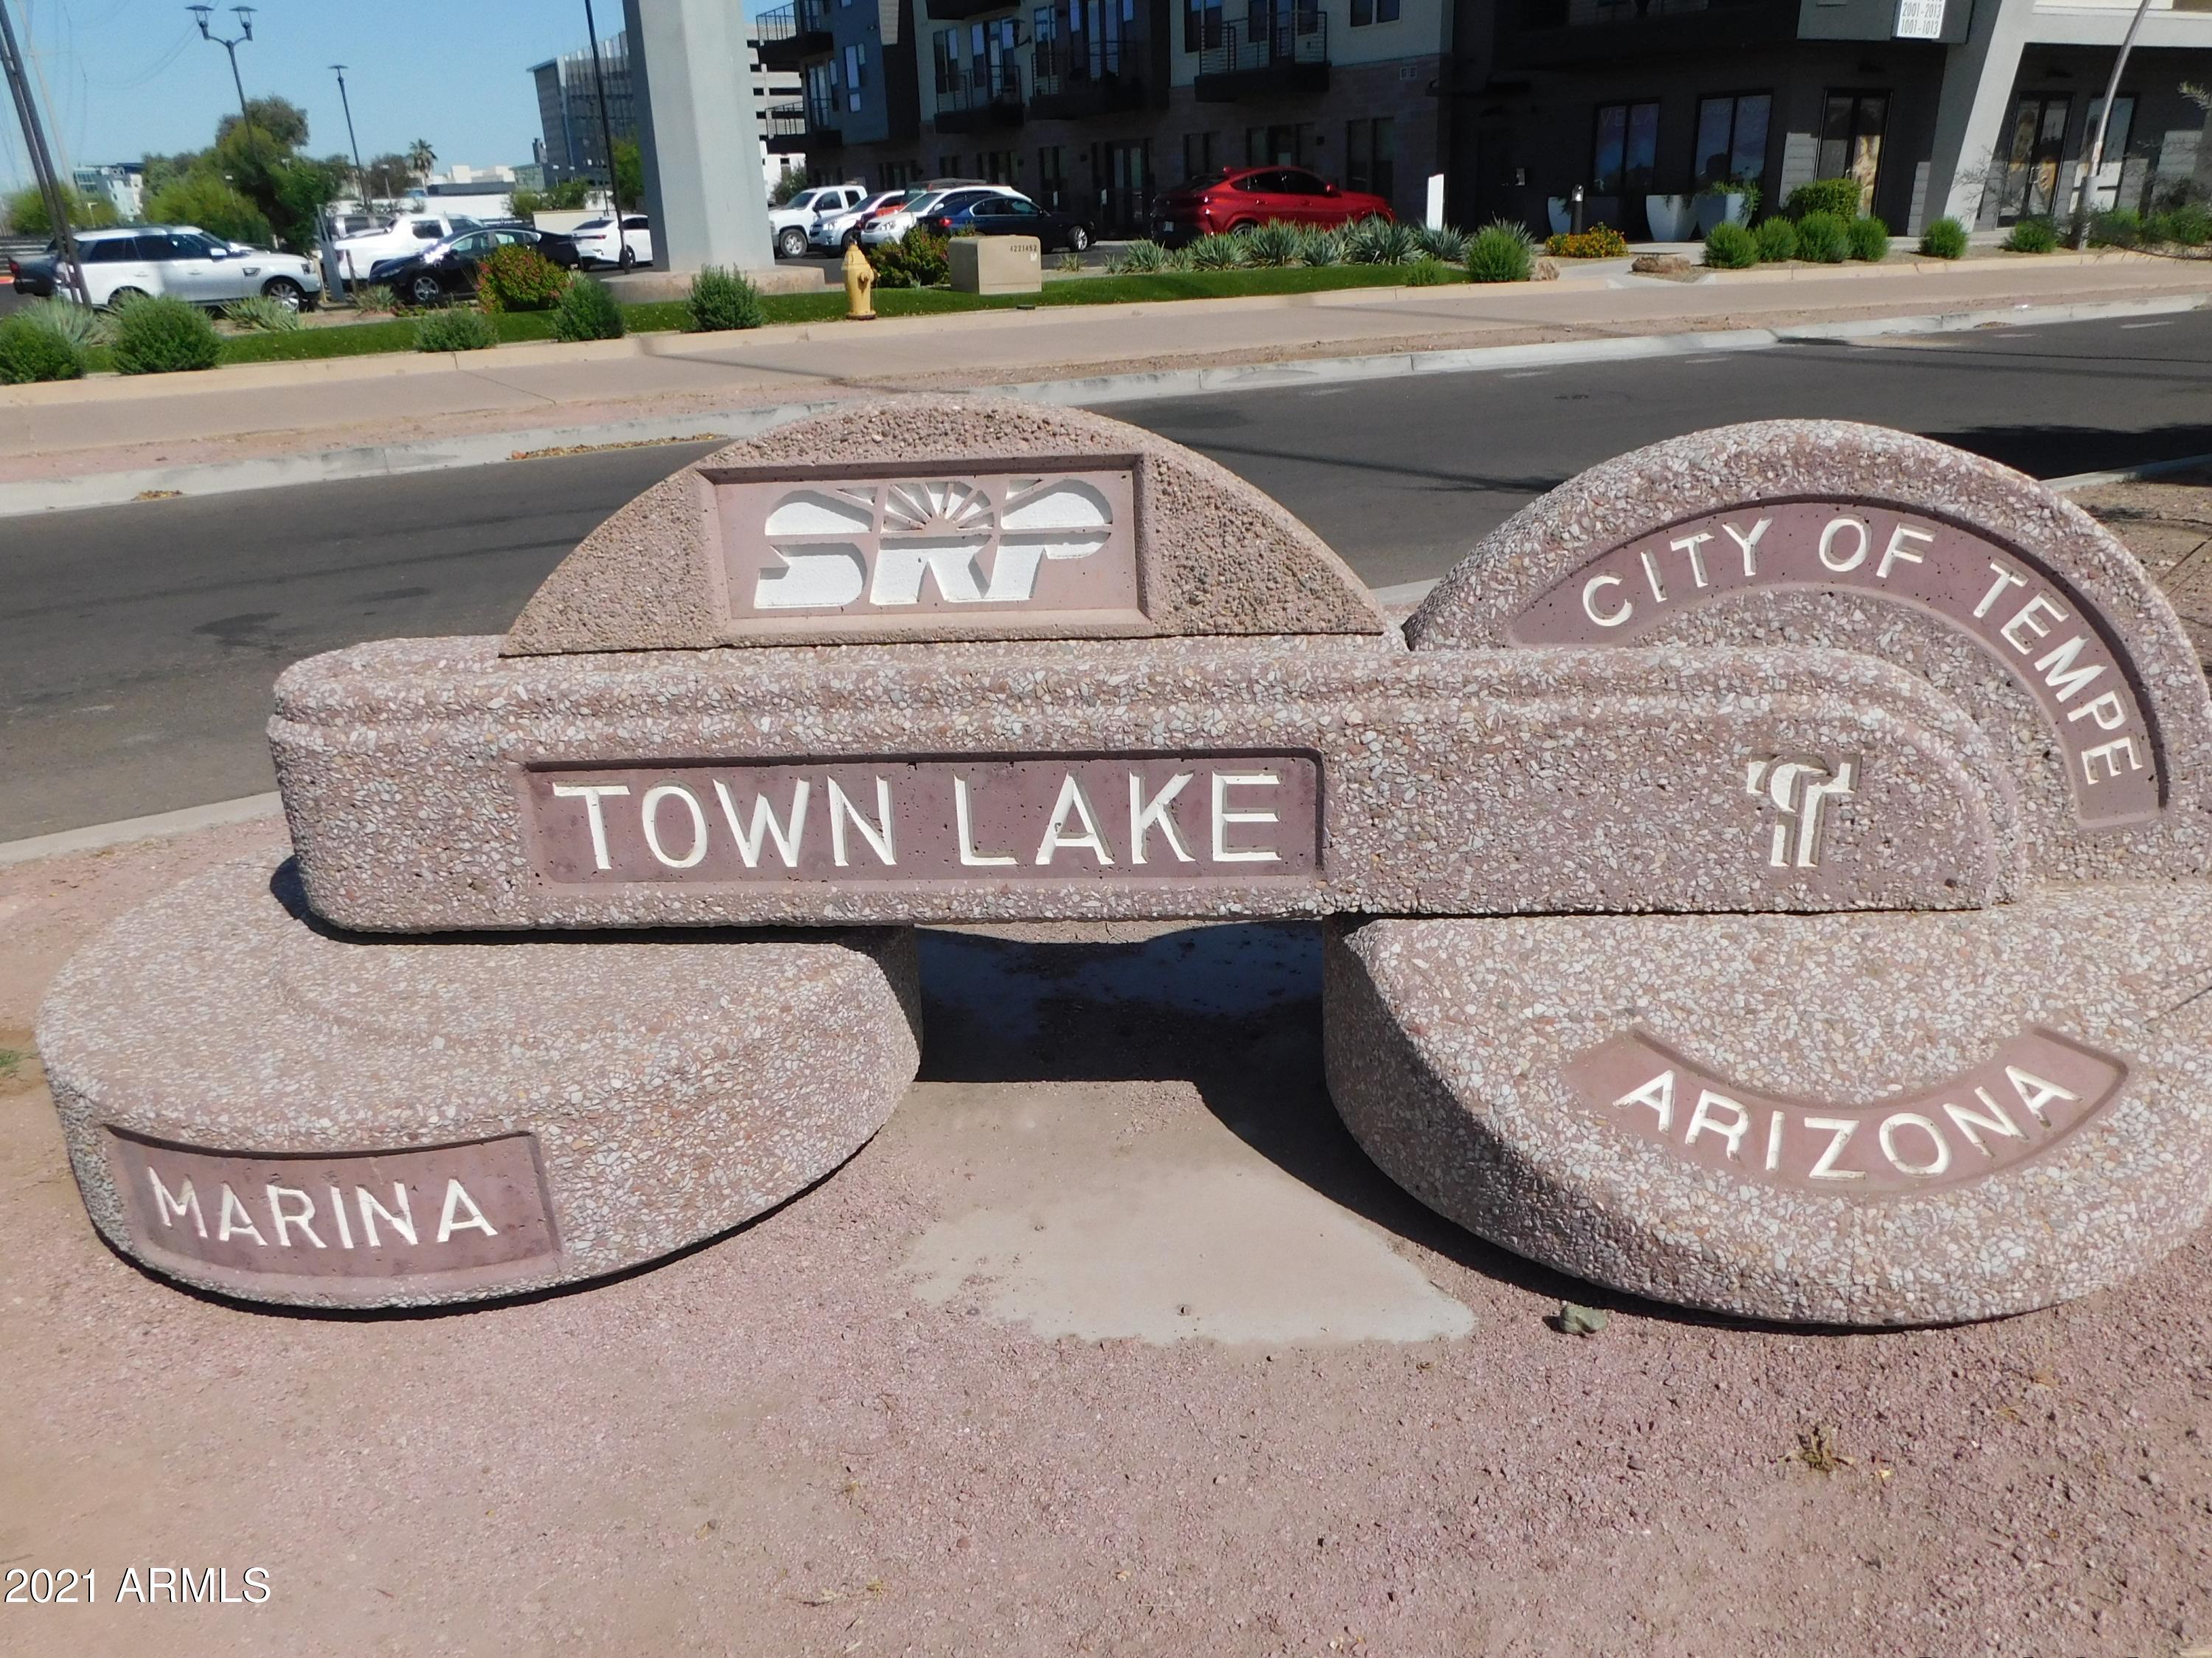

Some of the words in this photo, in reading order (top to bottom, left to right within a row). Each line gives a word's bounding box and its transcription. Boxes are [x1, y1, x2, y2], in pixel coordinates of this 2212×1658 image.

[1010, 244, 1037, 252] 4221452
[753, 479, 1113, 609] SRP
[1582, 517, 1773, 628] CITY
[1818, 514, 1937, 579] OF
[1972, 558, 2144, 787] TEMPE
[552, 773, 897, 871] TOWN
[953, 770, 1283, 867] LAKE
[1613, 1064, 2084, 1180] ARIZONA
[147, 1166, 498, 1250] MARINA
